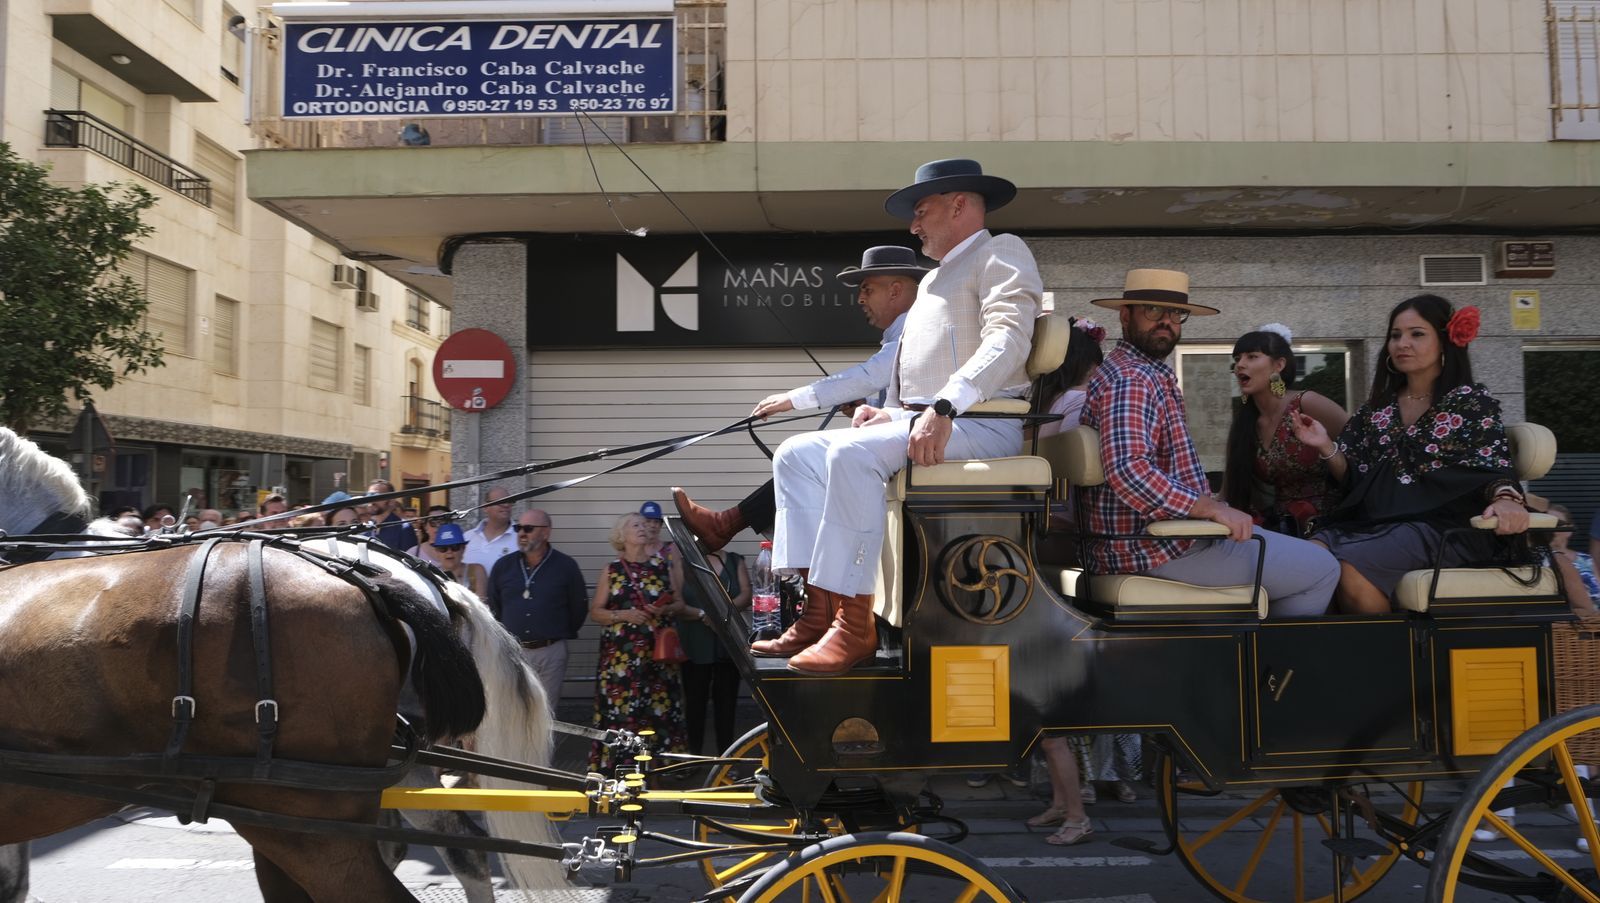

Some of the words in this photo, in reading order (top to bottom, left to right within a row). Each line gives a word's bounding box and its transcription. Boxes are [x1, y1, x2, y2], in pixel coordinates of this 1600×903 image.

[297, 26, 472, 54] CLINICA
[489, 23, 663, 51] DENTAL
[317, 63, 353, 79] Dr.
[362, 62, 468, 78] Francisco
[480, 61, 537, 76] Caba
[544, 60, 645, 76] Calvache
[315, 83, 352, 98] Dr.
[361, 81, 468, 100] Alejandro
[480, 81, 537, 96] Caba
[544, 80, 645, 95] Calvache
[293, 101, 430, 114] ORTODONCIA
[516, 99, 534, 111] 19
[538, 99, 558, 111] 53
[569, 98, 623, 111] 950-23
[626, 98, 646, 110] 76
[650, 97, 670, 110] 97
[723, 262, 824, 288] MAÑAS
[723, 294, 857, 307] INMOBILI
